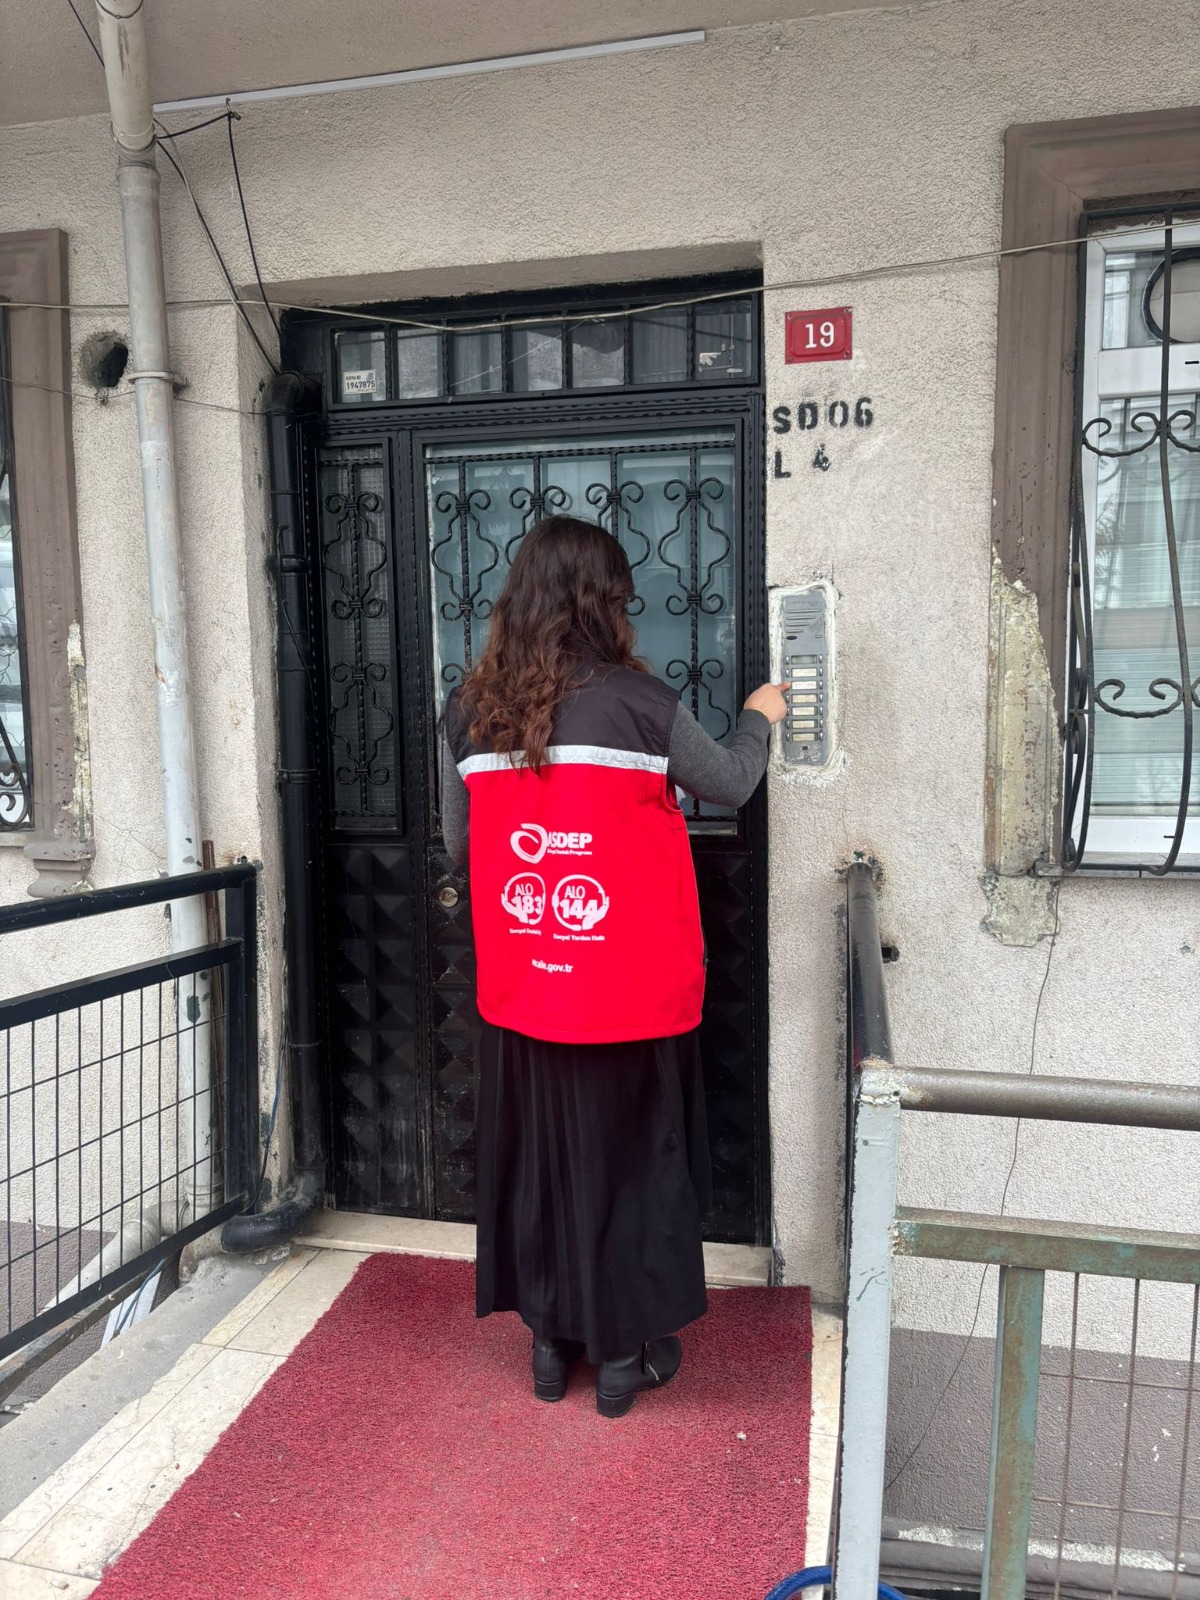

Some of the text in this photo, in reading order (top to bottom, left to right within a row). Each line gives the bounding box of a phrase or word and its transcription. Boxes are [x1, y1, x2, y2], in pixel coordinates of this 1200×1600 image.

[804, 321, 835, 349] 19
[346, 380, 376, 390] 1947875
[774, 449, 792, 479] L
[515, 883, 534, 896] ALO
[564, 885, 586, 899] ALO
[511, 895, 542, 915] 183
[559, 899, 598, 919] 144
